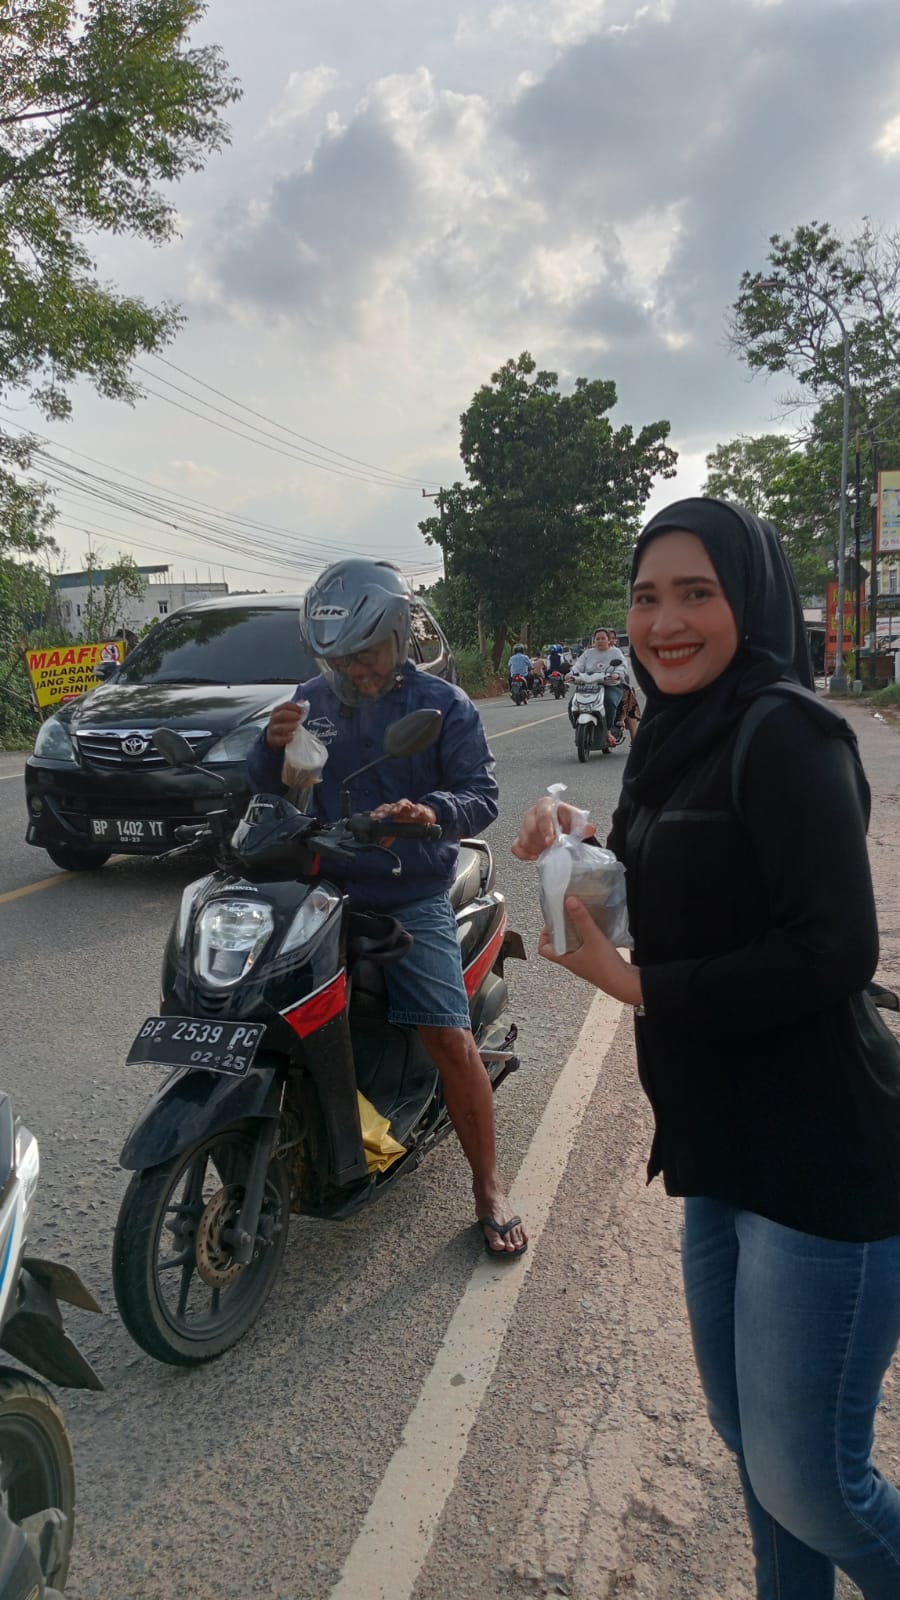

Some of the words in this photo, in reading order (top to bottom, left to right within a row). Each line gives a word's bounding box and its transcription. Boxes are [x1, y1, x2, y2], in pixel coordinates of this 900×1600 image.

[312, 609, 345, 617] INK
[29, 647, 97, 671] MAAF!
[41, 665, 94, 678] DILARAN
[68, 675, 98, 684] SAM
[50, 685, 88, 696] DISINI
[92, 820, 108, 835] BP
[116, 821, 145, 836] 1402
[148, 821, 163, 836] YT
[140, 1020, 166, 1038] BP
[171, 1022, 224, 1043] 2539
[227, 1027, 259, 1048] PC
